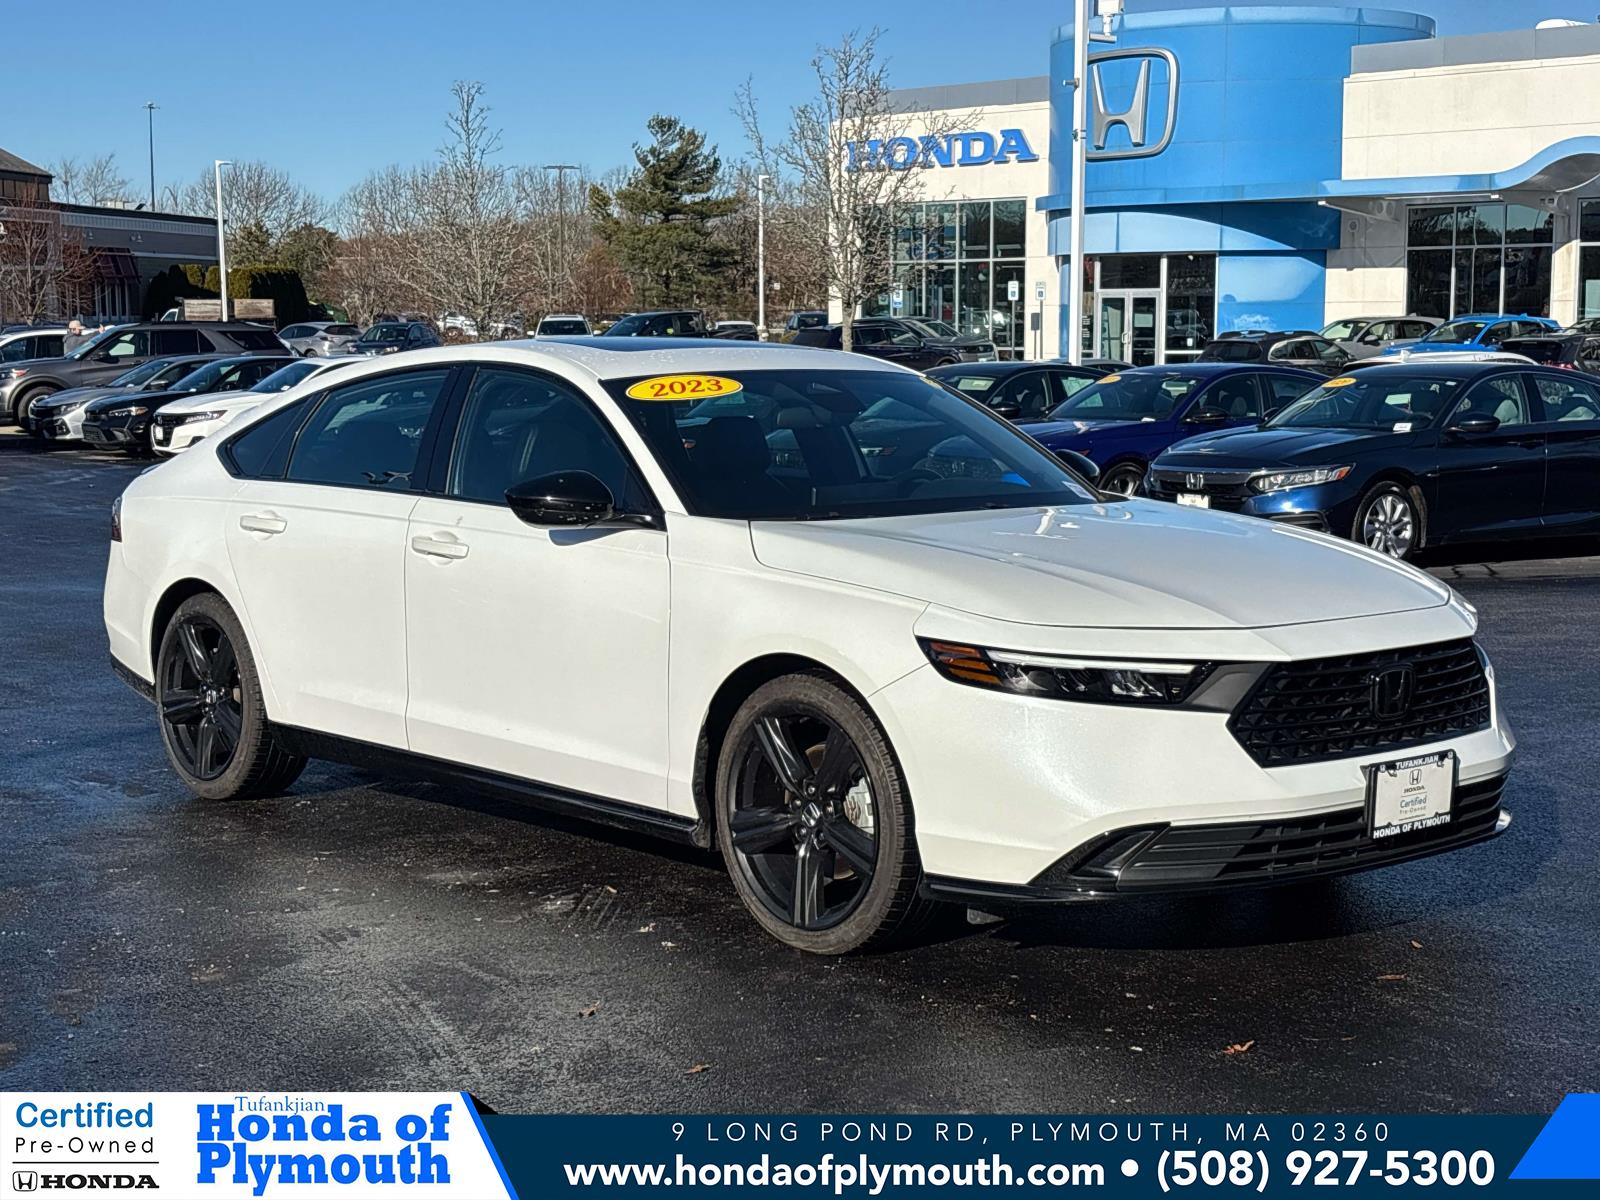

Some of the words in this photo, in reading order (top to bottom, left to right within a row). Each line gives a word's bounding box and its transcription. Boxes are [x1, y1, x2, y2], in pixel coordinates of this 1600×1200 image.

[845, 128, 1040, 172] HONDA
[650, 379, 723, 397] 2023
[1396, 755, 1439, 769] TUFANKJIAN
[1403, 785, 1425, 793] HONDA
[1400, 795, 1427, 808] Certified
[1373, 826, 1400, 839] HONDA
[1402, 822, 1411, 832] OF
[1413, 814, 1451, 830] PLYMOUTH
